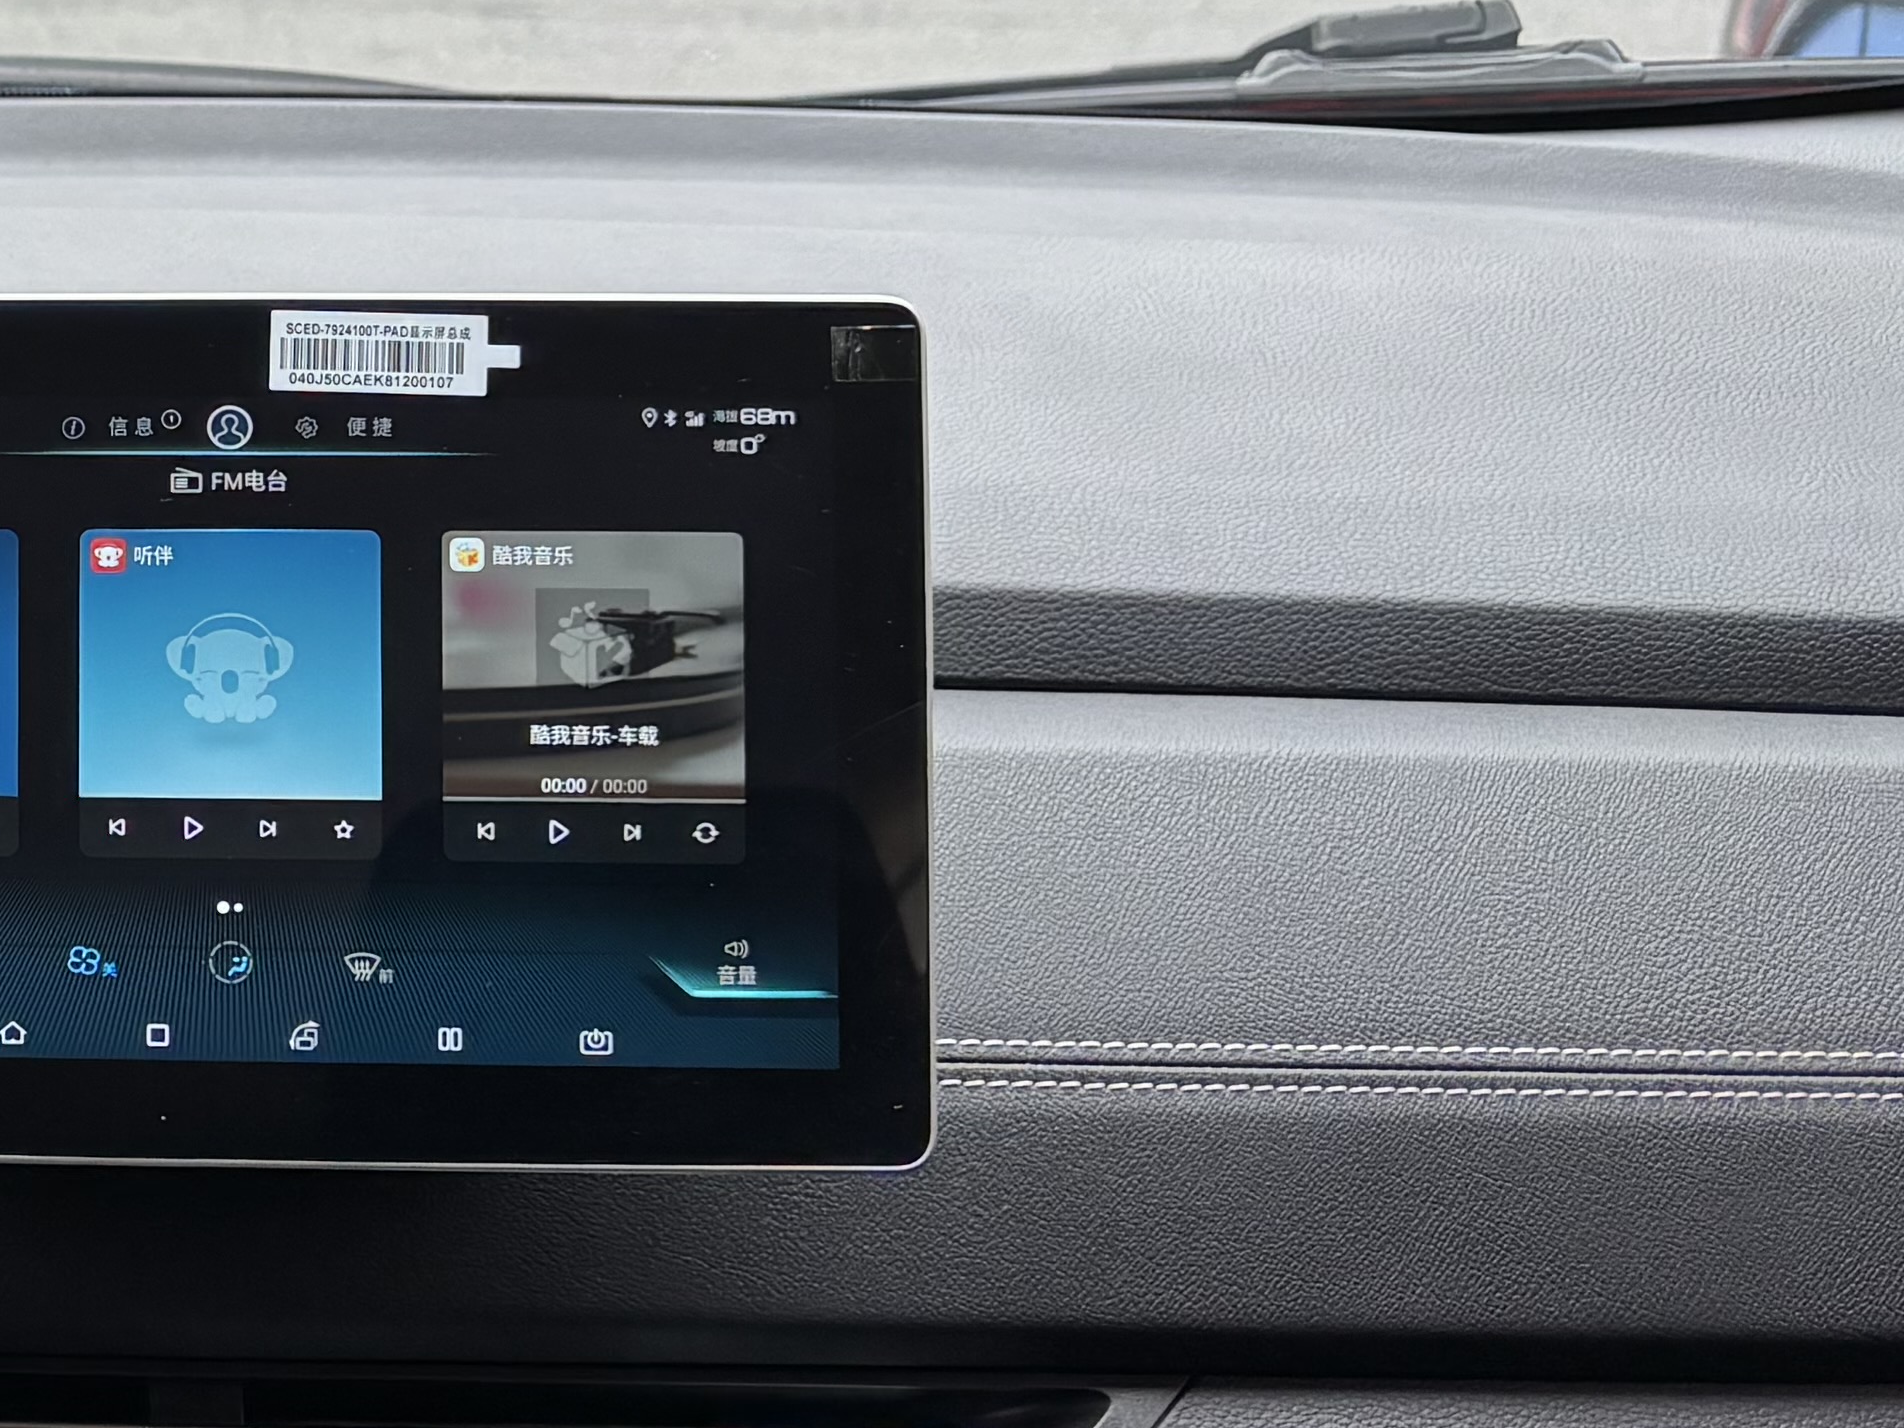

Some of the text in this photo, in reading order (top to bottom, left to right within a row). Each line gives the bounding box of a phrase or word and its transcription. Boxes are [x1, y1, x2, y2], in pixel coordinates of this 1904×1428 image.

[289, 373, 454, 389] 040J50CAEK81200107
[109, 416, 153, 437] 信息
[347, 416, 393, 438] 便捷
[210, 470, 288, 492] FM电台
[133, 545, 174, 566] 听伴
[492, 545, 573, 566] 酷我音乐
[529, 725, 660, 747] 酷我音乐-车载
[540, 777, 587, 794] 00:00
[602, 778, 647, 795] 00:00
[717, 965, 757, 986] 音量
